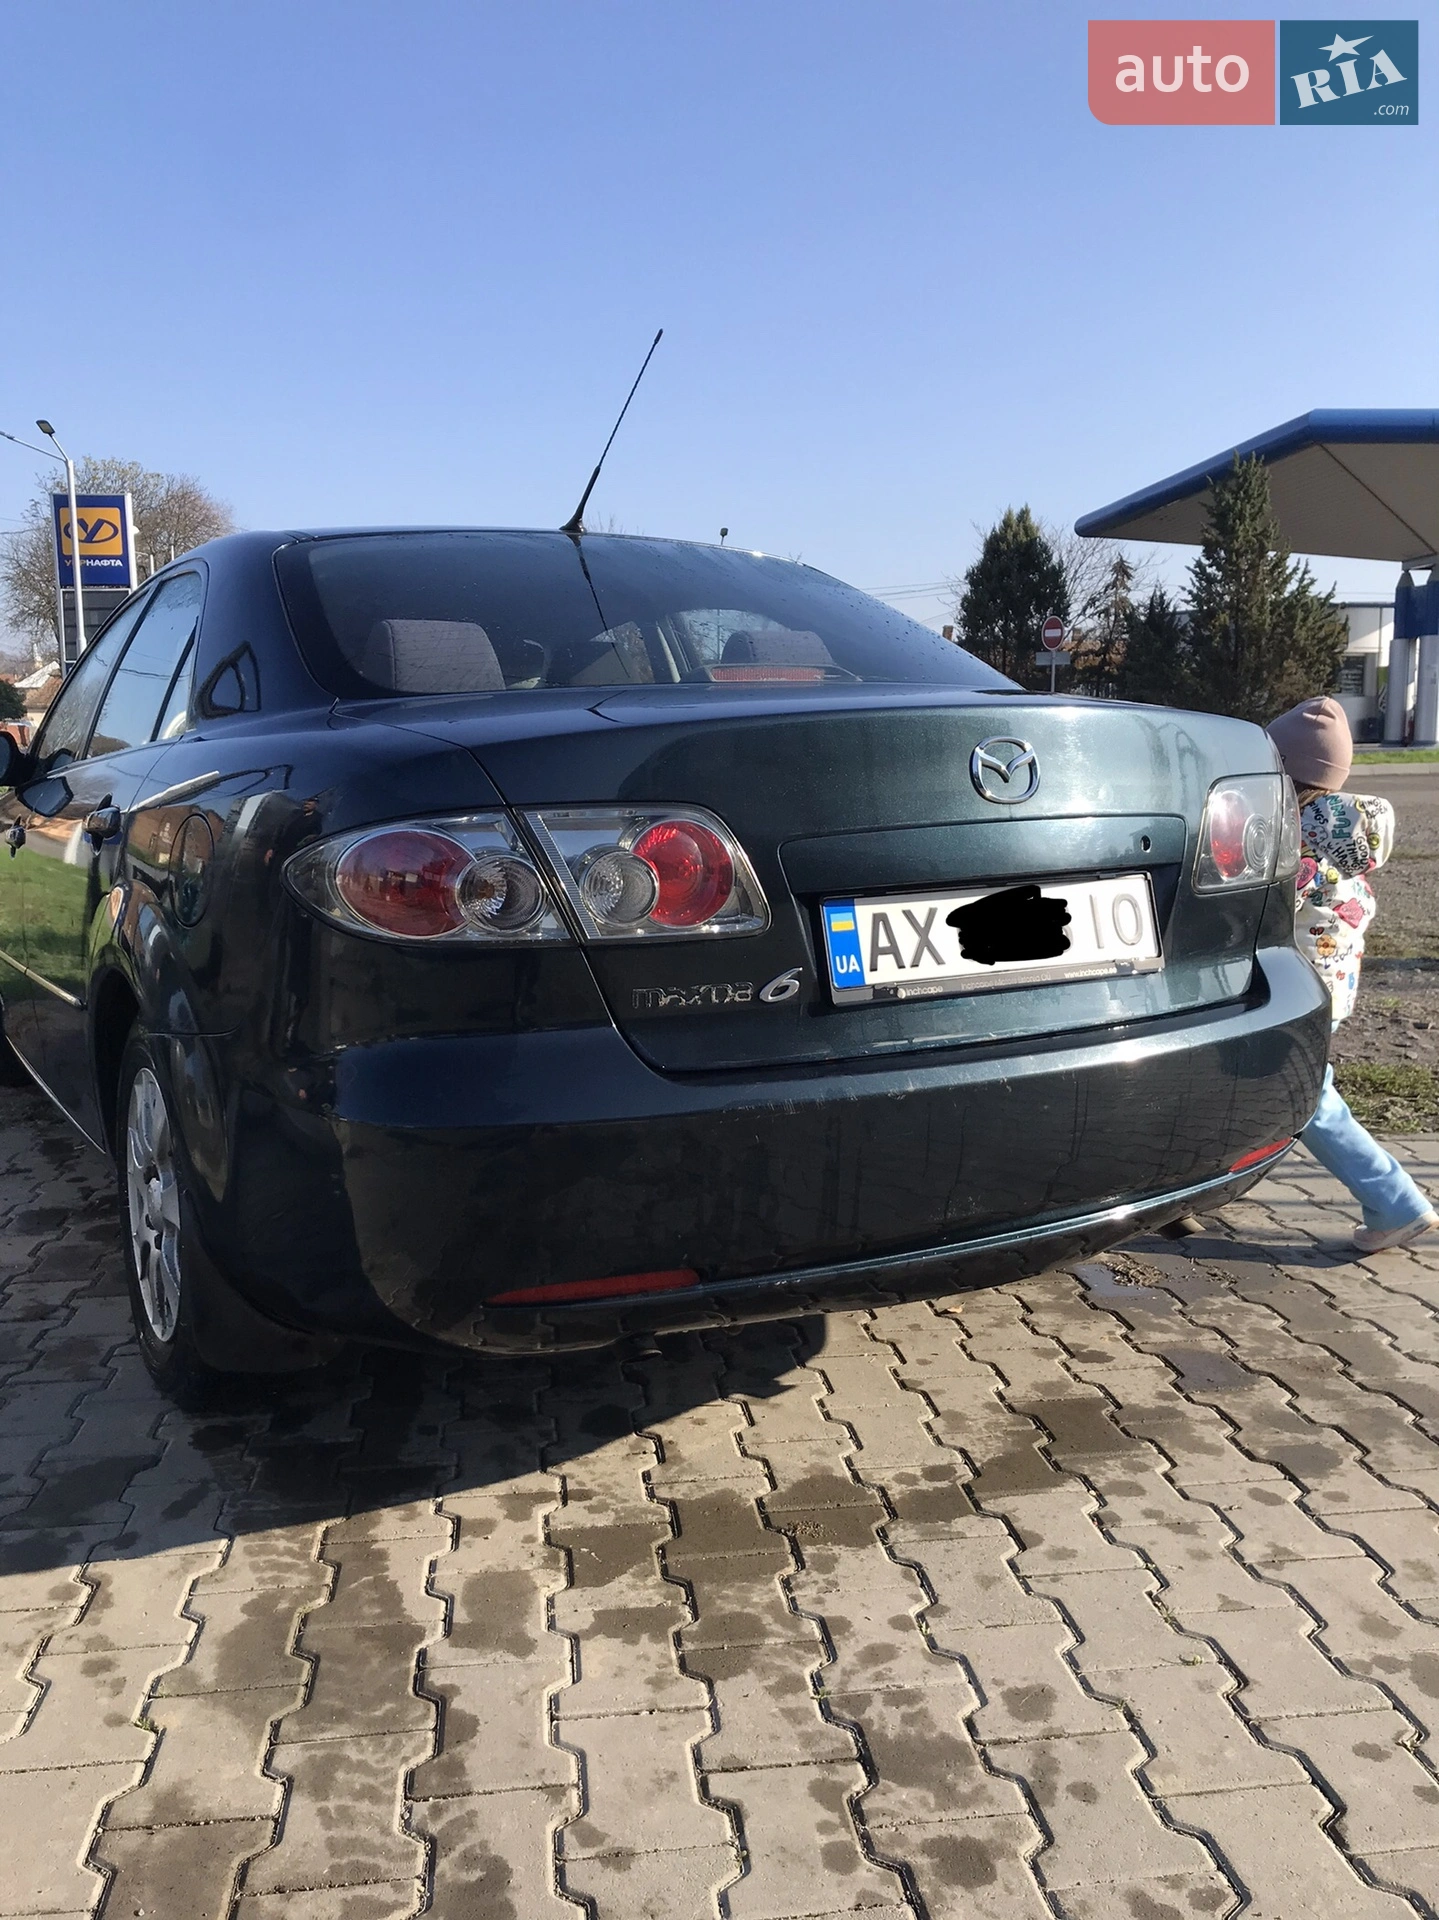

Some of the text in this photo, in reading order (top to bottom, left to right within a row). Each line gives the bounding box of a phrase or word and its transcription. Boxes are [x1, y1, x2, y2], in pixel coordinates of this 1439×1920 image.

[64, 559, 123, 567] УРНАФТА
[1324, 795, 1351, 839] FUNN
[869, 907, 946, 972] AX
[835, 954, 861, 974] UA
[759, 967, 803, 1003] 6
